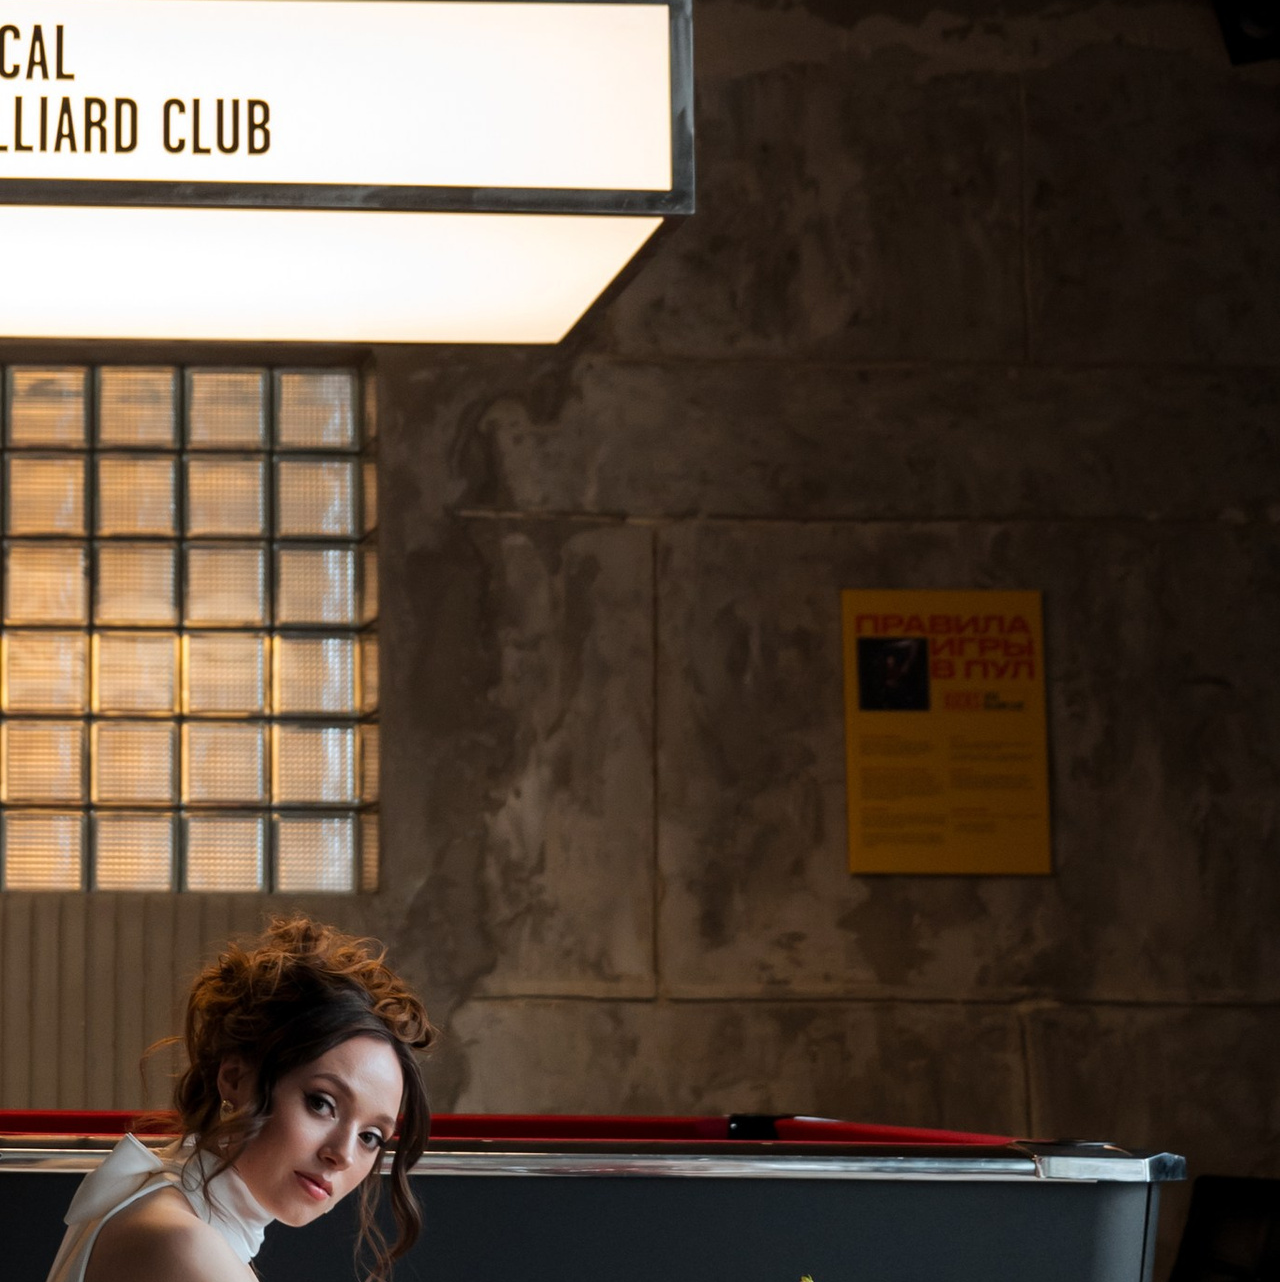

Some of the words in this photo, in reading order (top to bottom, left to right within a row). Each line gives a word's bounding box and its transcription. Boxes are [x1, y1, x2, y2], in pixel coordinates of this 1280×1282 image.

[161, 98, 273, 156] CLUB
[855, 614, 1031, 635] ПРАВИЛА
[930, 637, 1034, 657] ИГРЫ
[931, 659, 955, 680] В
[964, 659, 1036, 681] ПУЛ
